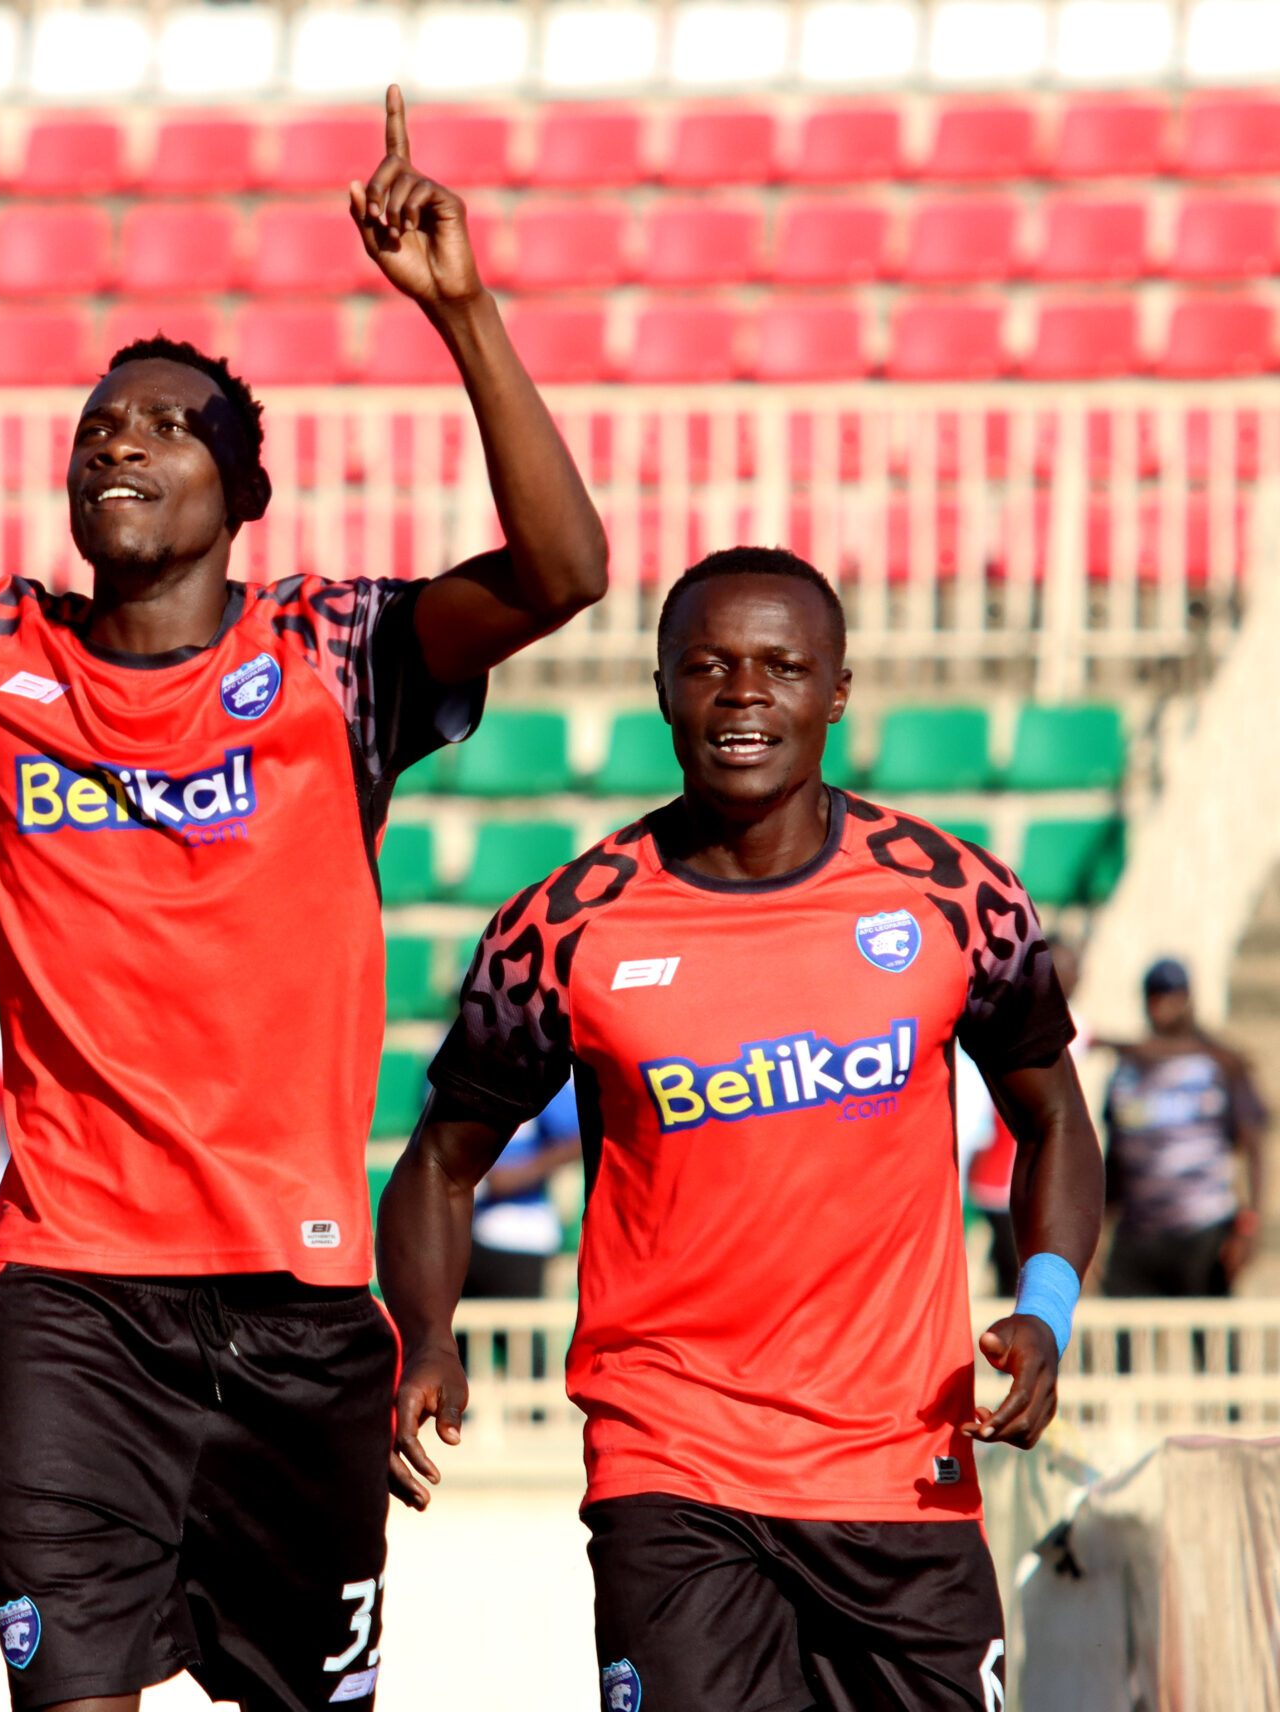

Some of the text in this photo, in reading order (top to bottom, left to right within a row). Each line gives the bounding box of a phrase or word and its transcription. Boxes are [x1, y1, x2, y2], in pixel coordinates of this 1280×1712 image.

[20, 755, 250, 826] Betika!
[647, 1026, 912, 1125] Betika!
[837, 1096, 898, 1123] .com
[323, 1573, 384, 1672] 3
